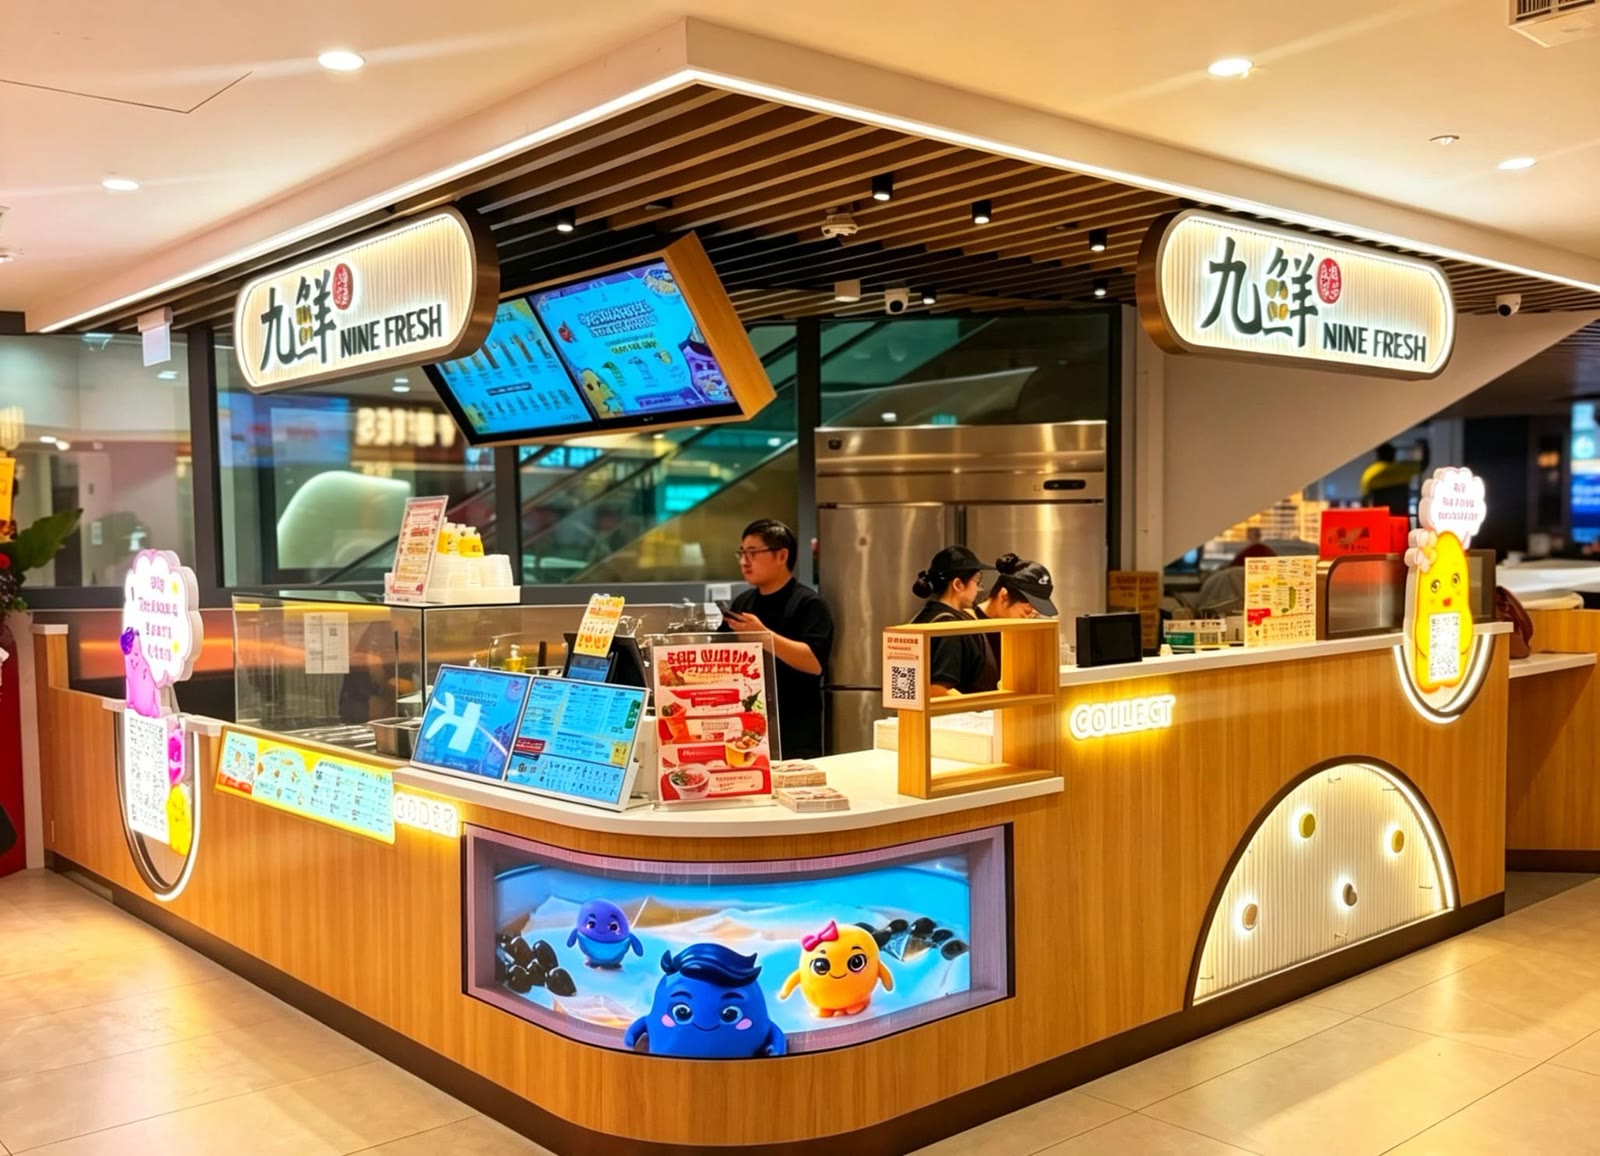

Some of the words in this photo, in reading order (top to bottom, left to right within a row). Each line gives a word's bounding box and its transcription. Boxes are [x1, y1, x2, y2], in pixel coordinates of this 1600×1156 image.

[340, 320, 381, 358] NINE
[384, 303, 443, 348] FRESH
[1323, 322, 1368, 355] NINE
[1373, 329, 1427, 362] FRESH
[1071, 694, 1175, 738] COLLECT
